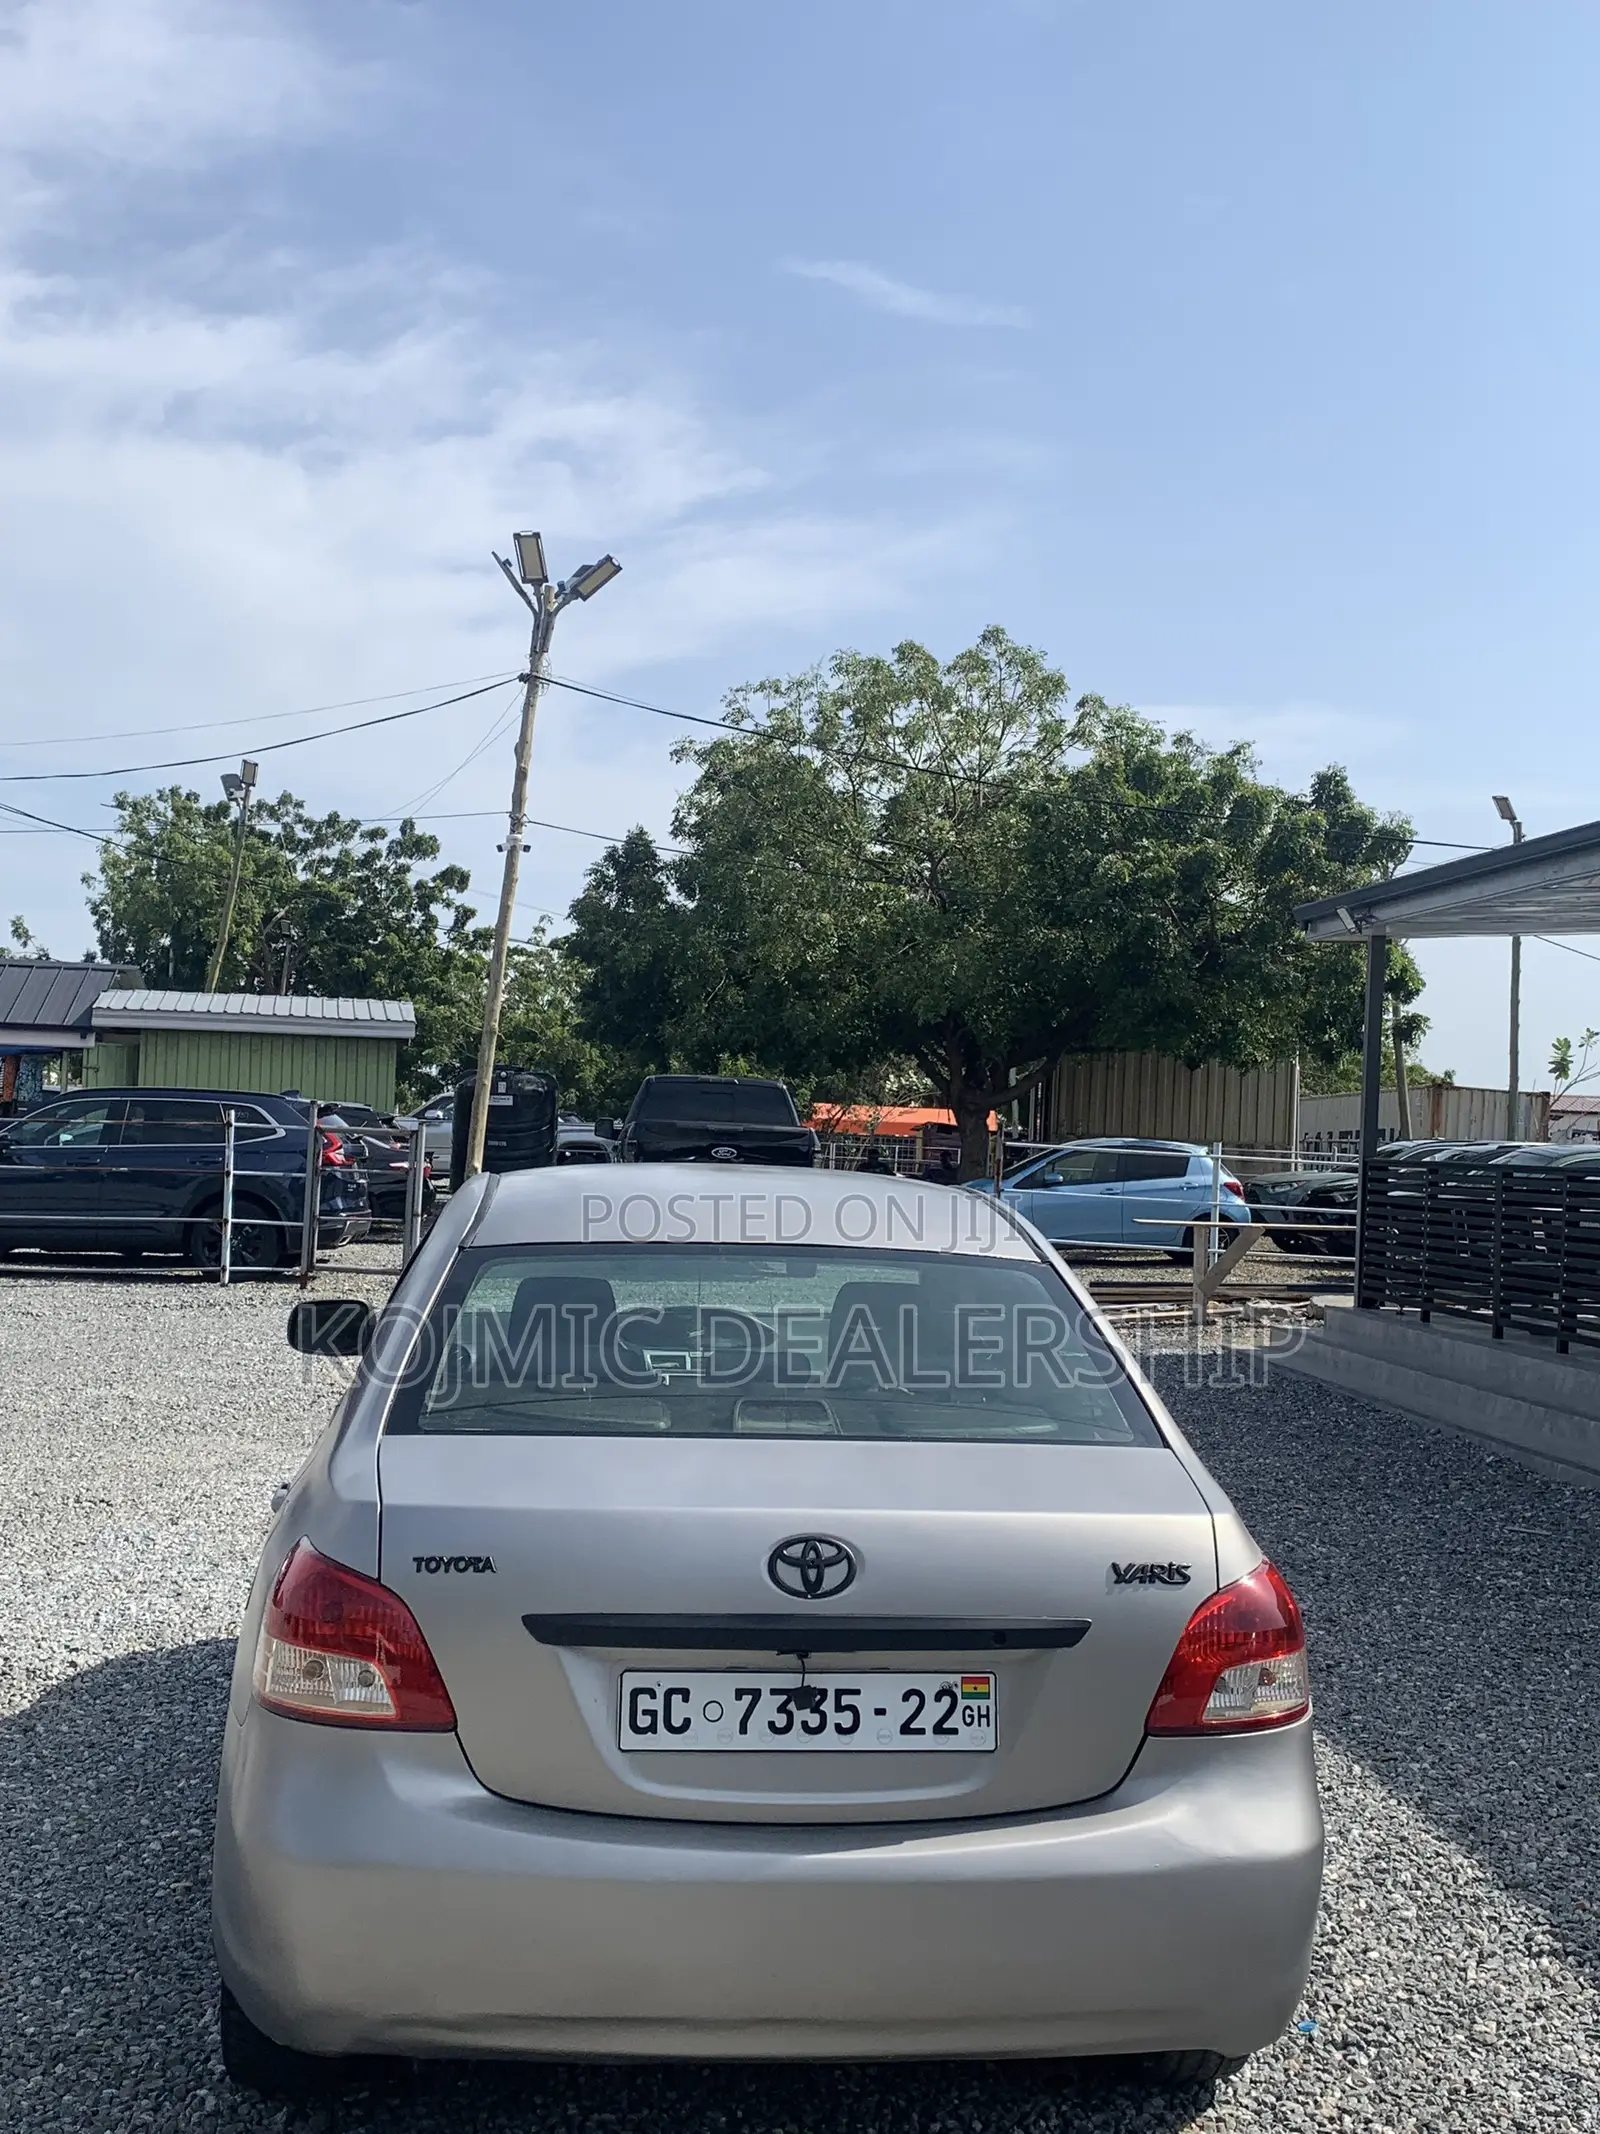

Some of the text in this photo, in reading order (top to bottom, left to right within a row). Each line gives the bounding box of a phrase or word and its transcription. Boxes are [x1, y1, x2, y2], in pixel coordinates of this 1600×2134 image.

[412, 1556, 497, 1574] TOYOTA
[629, 1687, 692, 1735] GC
[961, 1704, 991, 1728] GH
